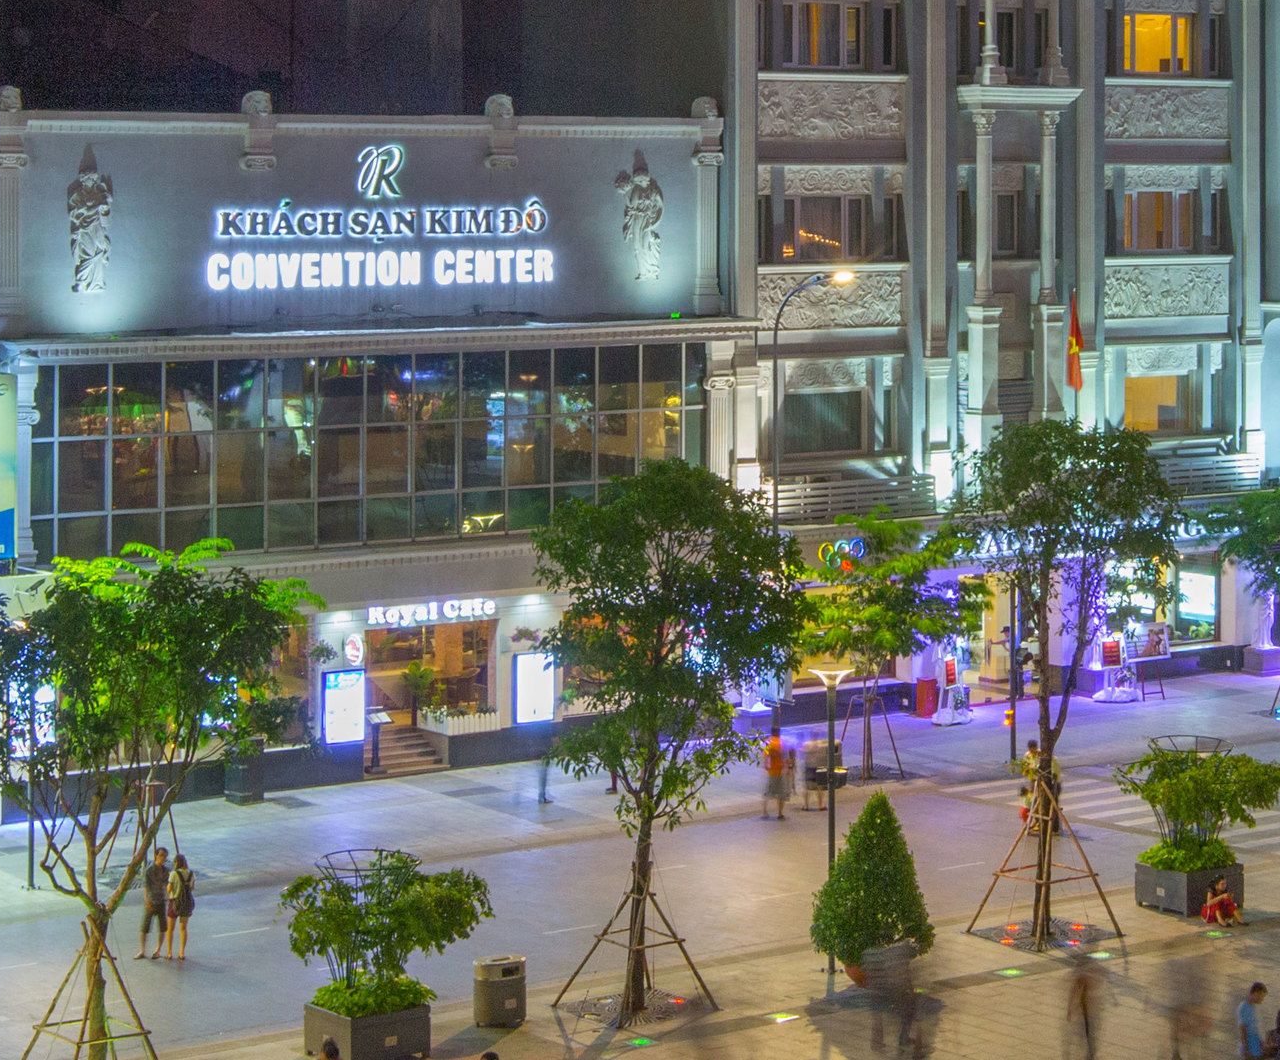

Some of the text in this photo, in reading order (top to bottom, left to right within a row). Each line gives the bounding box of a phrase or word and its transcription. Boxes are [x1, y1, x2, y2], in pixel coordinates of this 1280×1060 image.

[217, 198, 548, 244] KHÁCH SẠN KIM ĐÔ
[206, 248, 555, 291] CONVENTION CENTER
[367, 601, 439, 627] Royal
